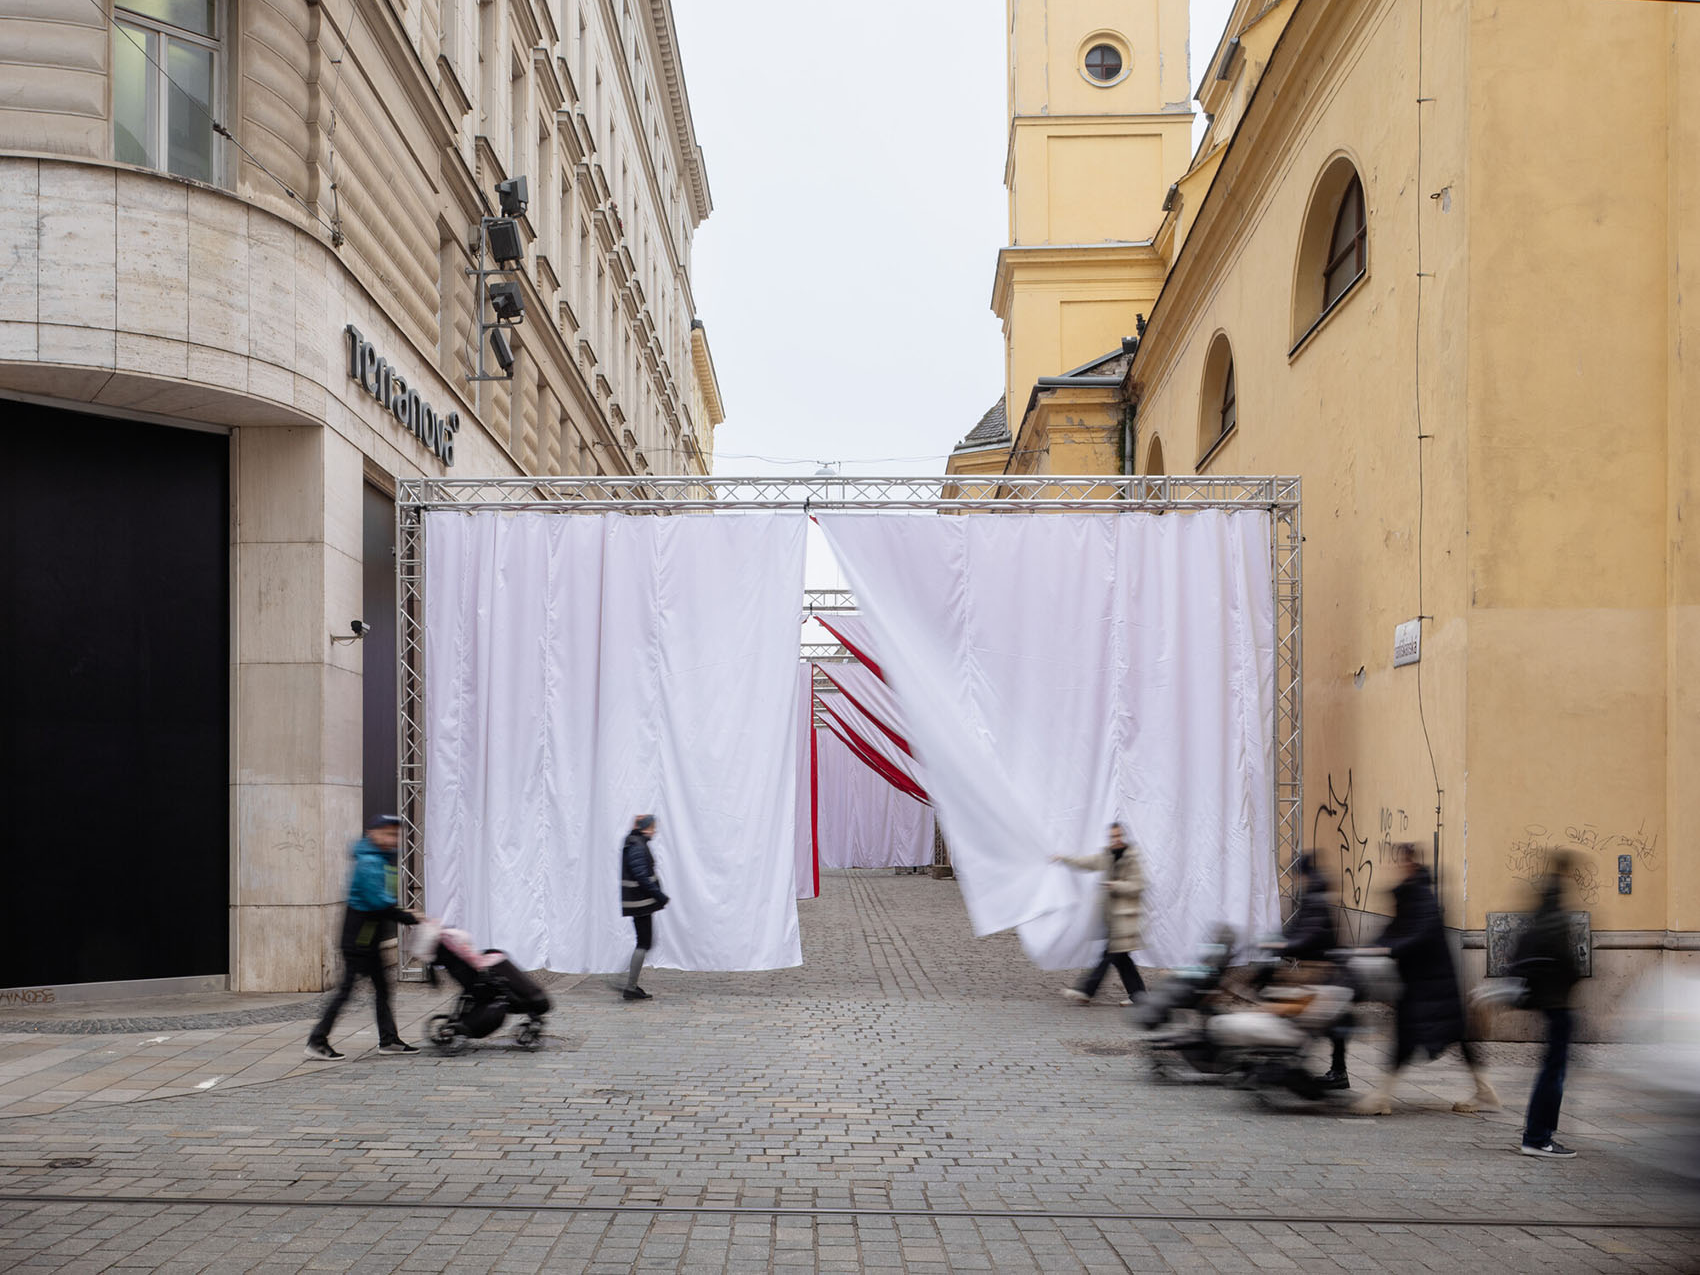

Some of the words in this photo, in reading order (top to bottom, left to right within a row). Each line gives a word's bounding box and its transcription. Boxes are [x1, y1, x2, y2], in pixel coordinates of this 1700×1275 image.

[344, 324, 455, 467] Terranova
[1380, 807, 1392, 832] NO
[1397, 809, 1408, 832] TO
